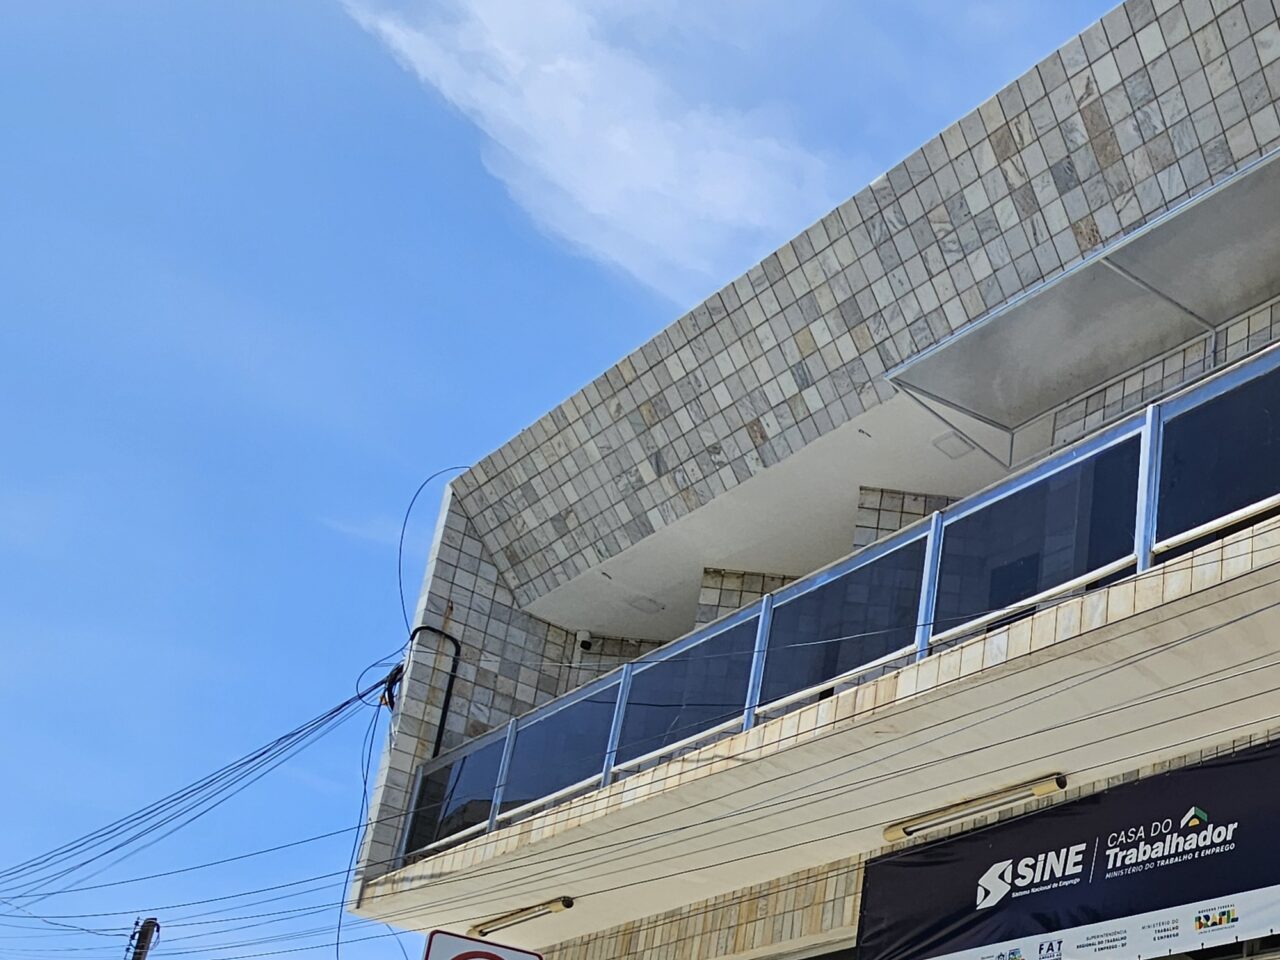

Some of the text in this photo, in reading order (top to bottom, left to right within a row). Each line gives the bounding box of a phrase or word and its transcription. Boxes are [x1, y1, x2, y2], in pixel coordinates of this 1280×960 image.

[1107, 818, 1173, 848] CASA DO
[1105, 821, 1239, 870] Trabalhador
[1105, 864, 1144, 880] MINISTÉRIO
[1144, 862, 1155, 870] DO
[1156, 853, 1193, 867] TRABALHO
[1200, 842, 1236, 857] EMPREGO
[1031, 883, 1052, 893] Nacional
[1058, 878, 1081, 887] Emprego
[1141, 920, 1170, 930] MINISTÉRIO
[1154, 925, 1179, 934] TRABALHO
[1086, 929, 1127, 941] SUPERINTENDÊNCIA
[1038, 940, 1063, 955] FAT
[1076, 941, 1097, 949] REGIONAL
[1104, 936, 1127, 944] TRABALHO
[1097, 944, 1118, 952] EMPREGO
